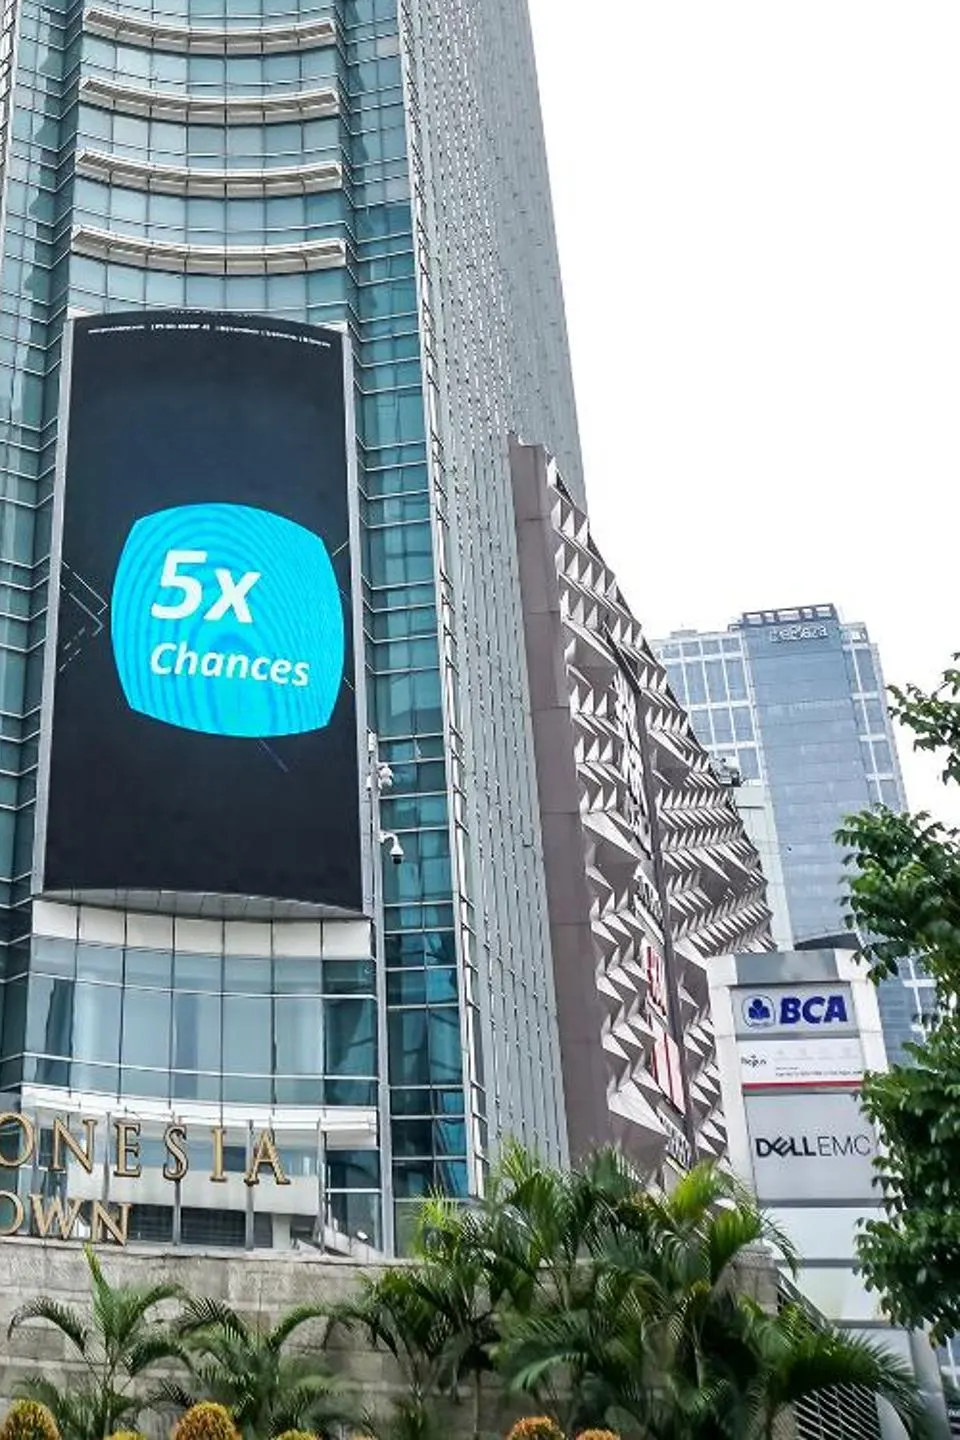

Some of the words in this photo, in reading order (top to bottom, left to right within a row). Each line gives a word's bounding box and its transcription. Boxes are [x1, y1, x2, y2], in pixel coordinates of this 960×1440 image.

[151, 549, 262, 623] 5x
[151, 641, 310, 687] Chances
[780, 996, 848, 1024] BCA
